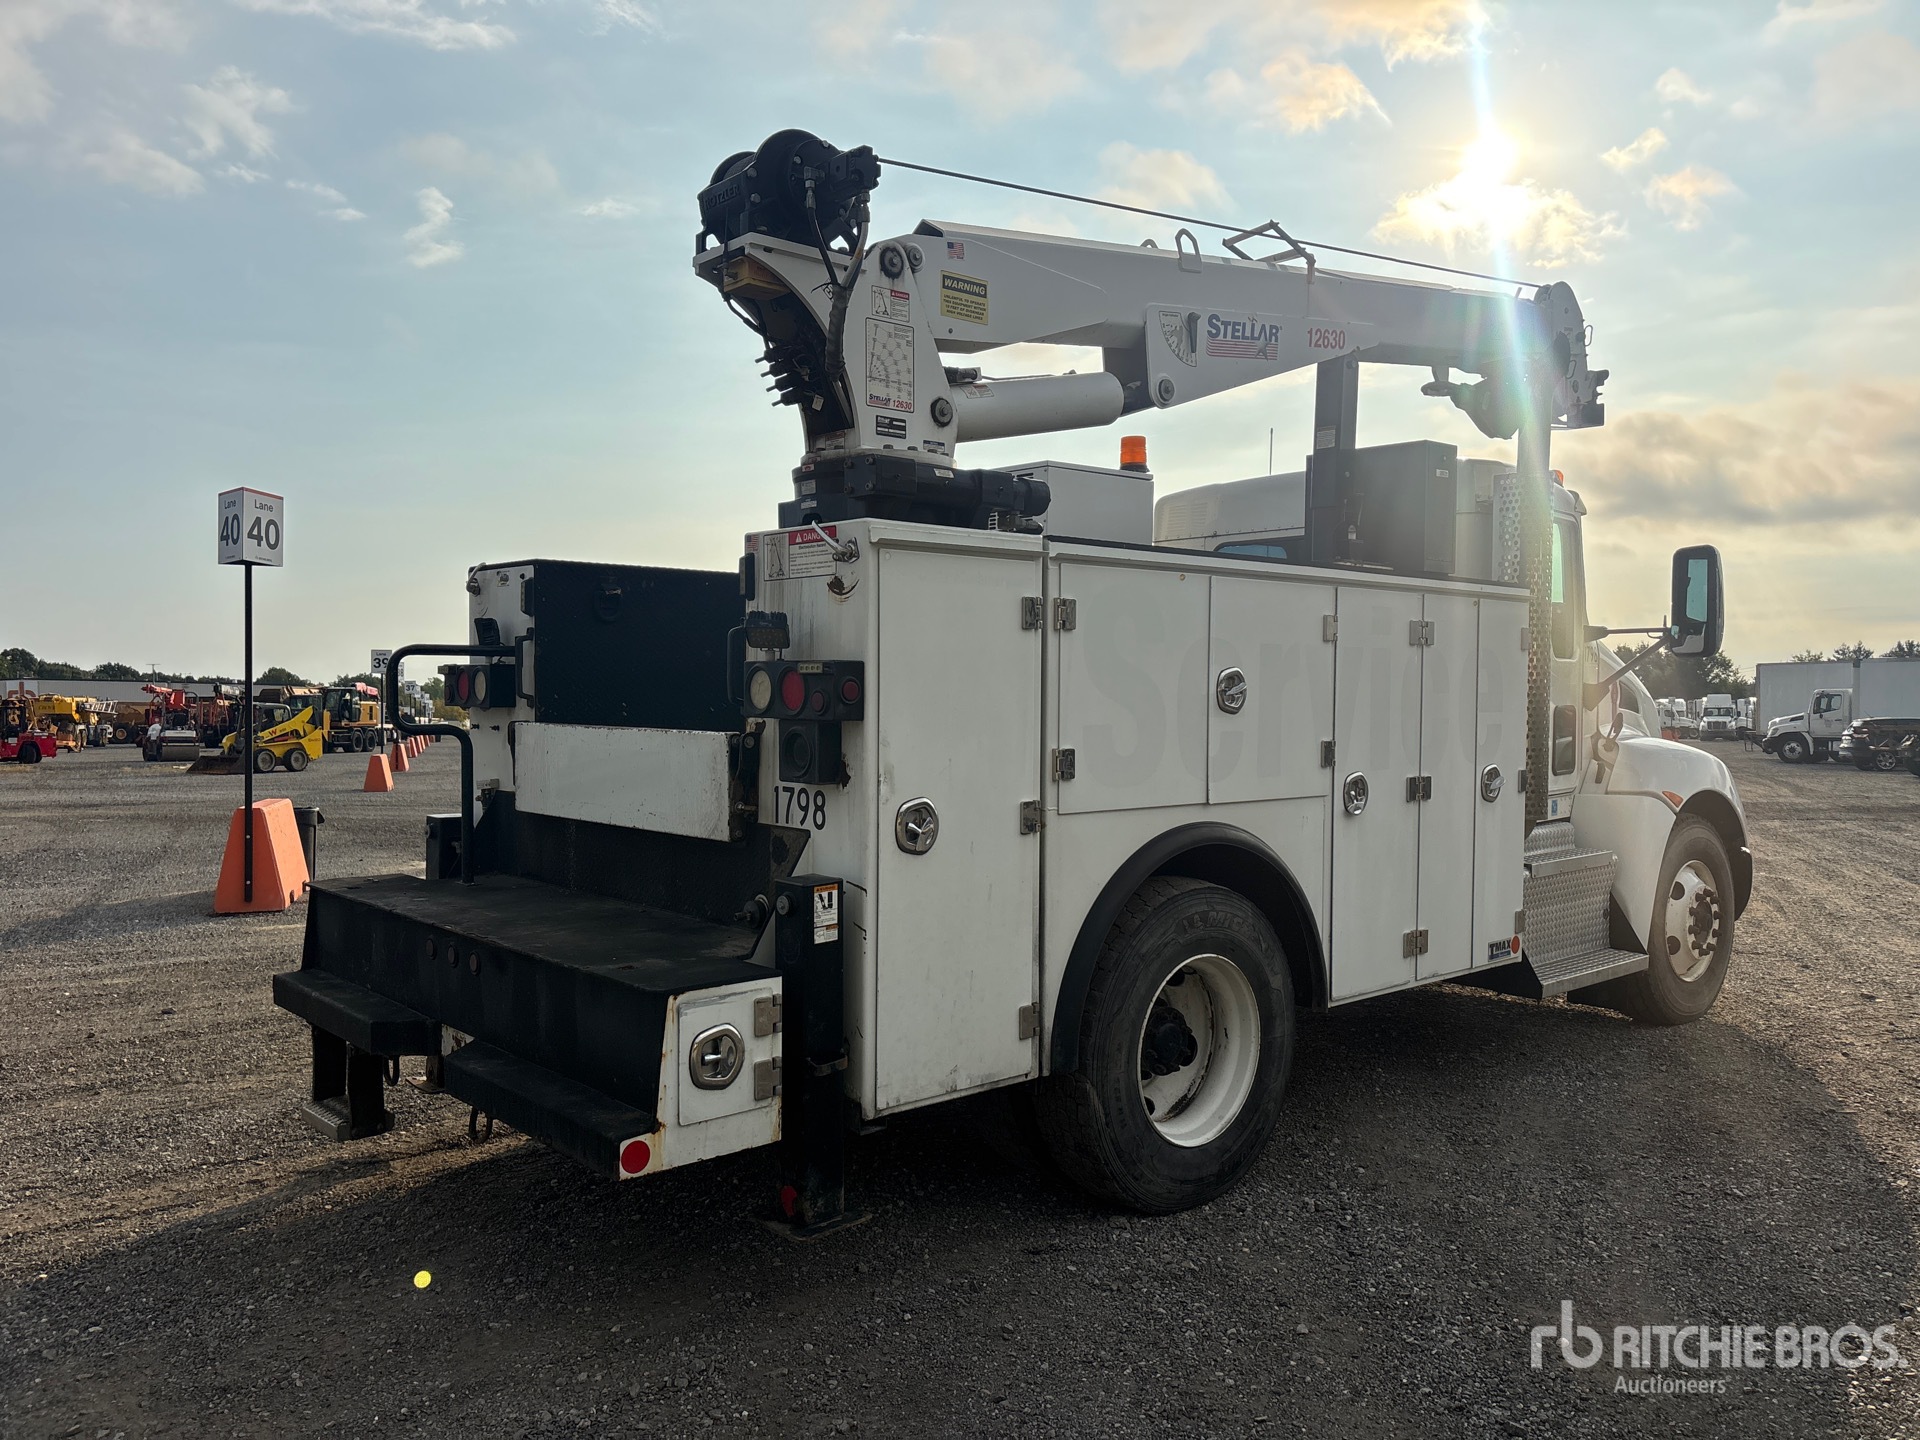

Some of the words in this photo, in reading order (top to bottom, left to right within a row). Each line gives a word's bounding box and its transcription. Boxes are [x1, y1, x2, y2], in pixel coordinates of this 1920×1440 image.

[704, 184, 740, 210] ROTZLER
[944, 278, 985, 295] WARNING
[1206, 313, 1279, 342] STELLAR
[1307, 327, 1346, 350] 12630
[869, 393, 892, 403] STELLAR
[893, 400, 913, 410] 12630
[224, 499, 236, 509] Lane
[254, 499, 274, 512] Lane
[220, 513, 240, 546] 40
[247, 516, 280, 550] 40
[803, 530, 829, 541] DANG
[373, 658, 389, 668] 39
[774, 785, 826, 830] 1798
[1490, 939, 1511, 954] TMAX
